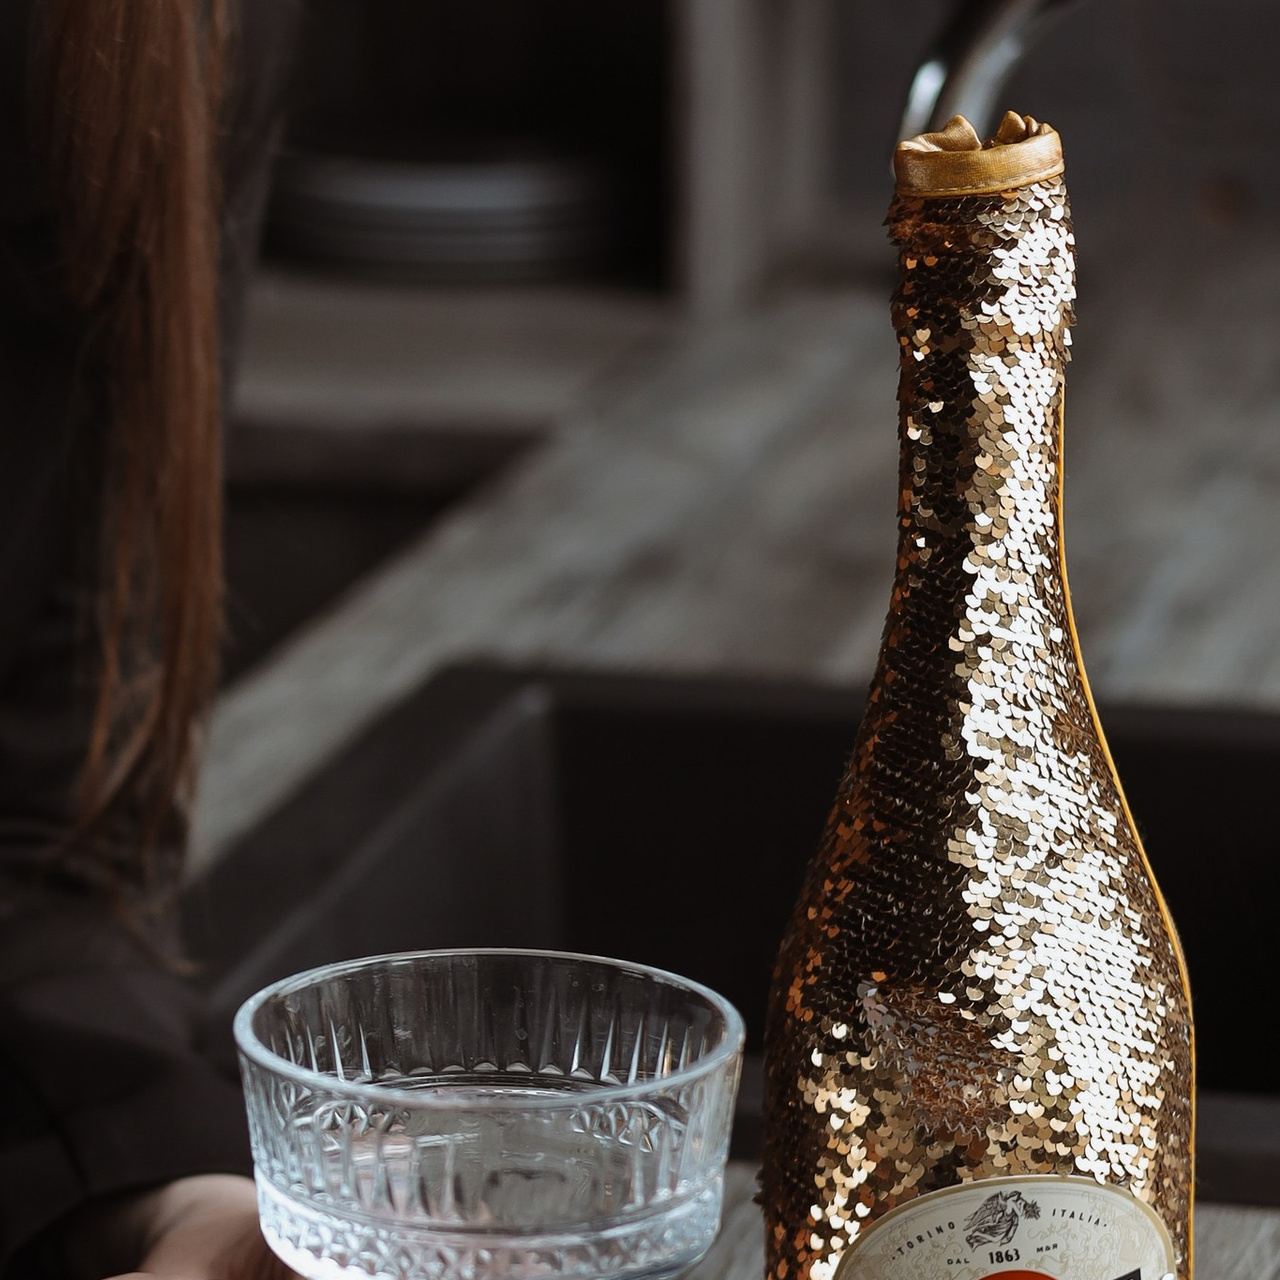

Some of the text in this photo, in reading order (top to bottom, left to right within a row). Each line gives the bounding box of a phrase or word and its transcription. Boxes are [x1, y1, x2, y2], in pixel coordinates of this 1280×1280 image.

[1052, 1208, 1100, 1227] ITALIA
[897, 1221, 955, 1255] TORINO
[988, 1248, 1021, 1264] 1863
